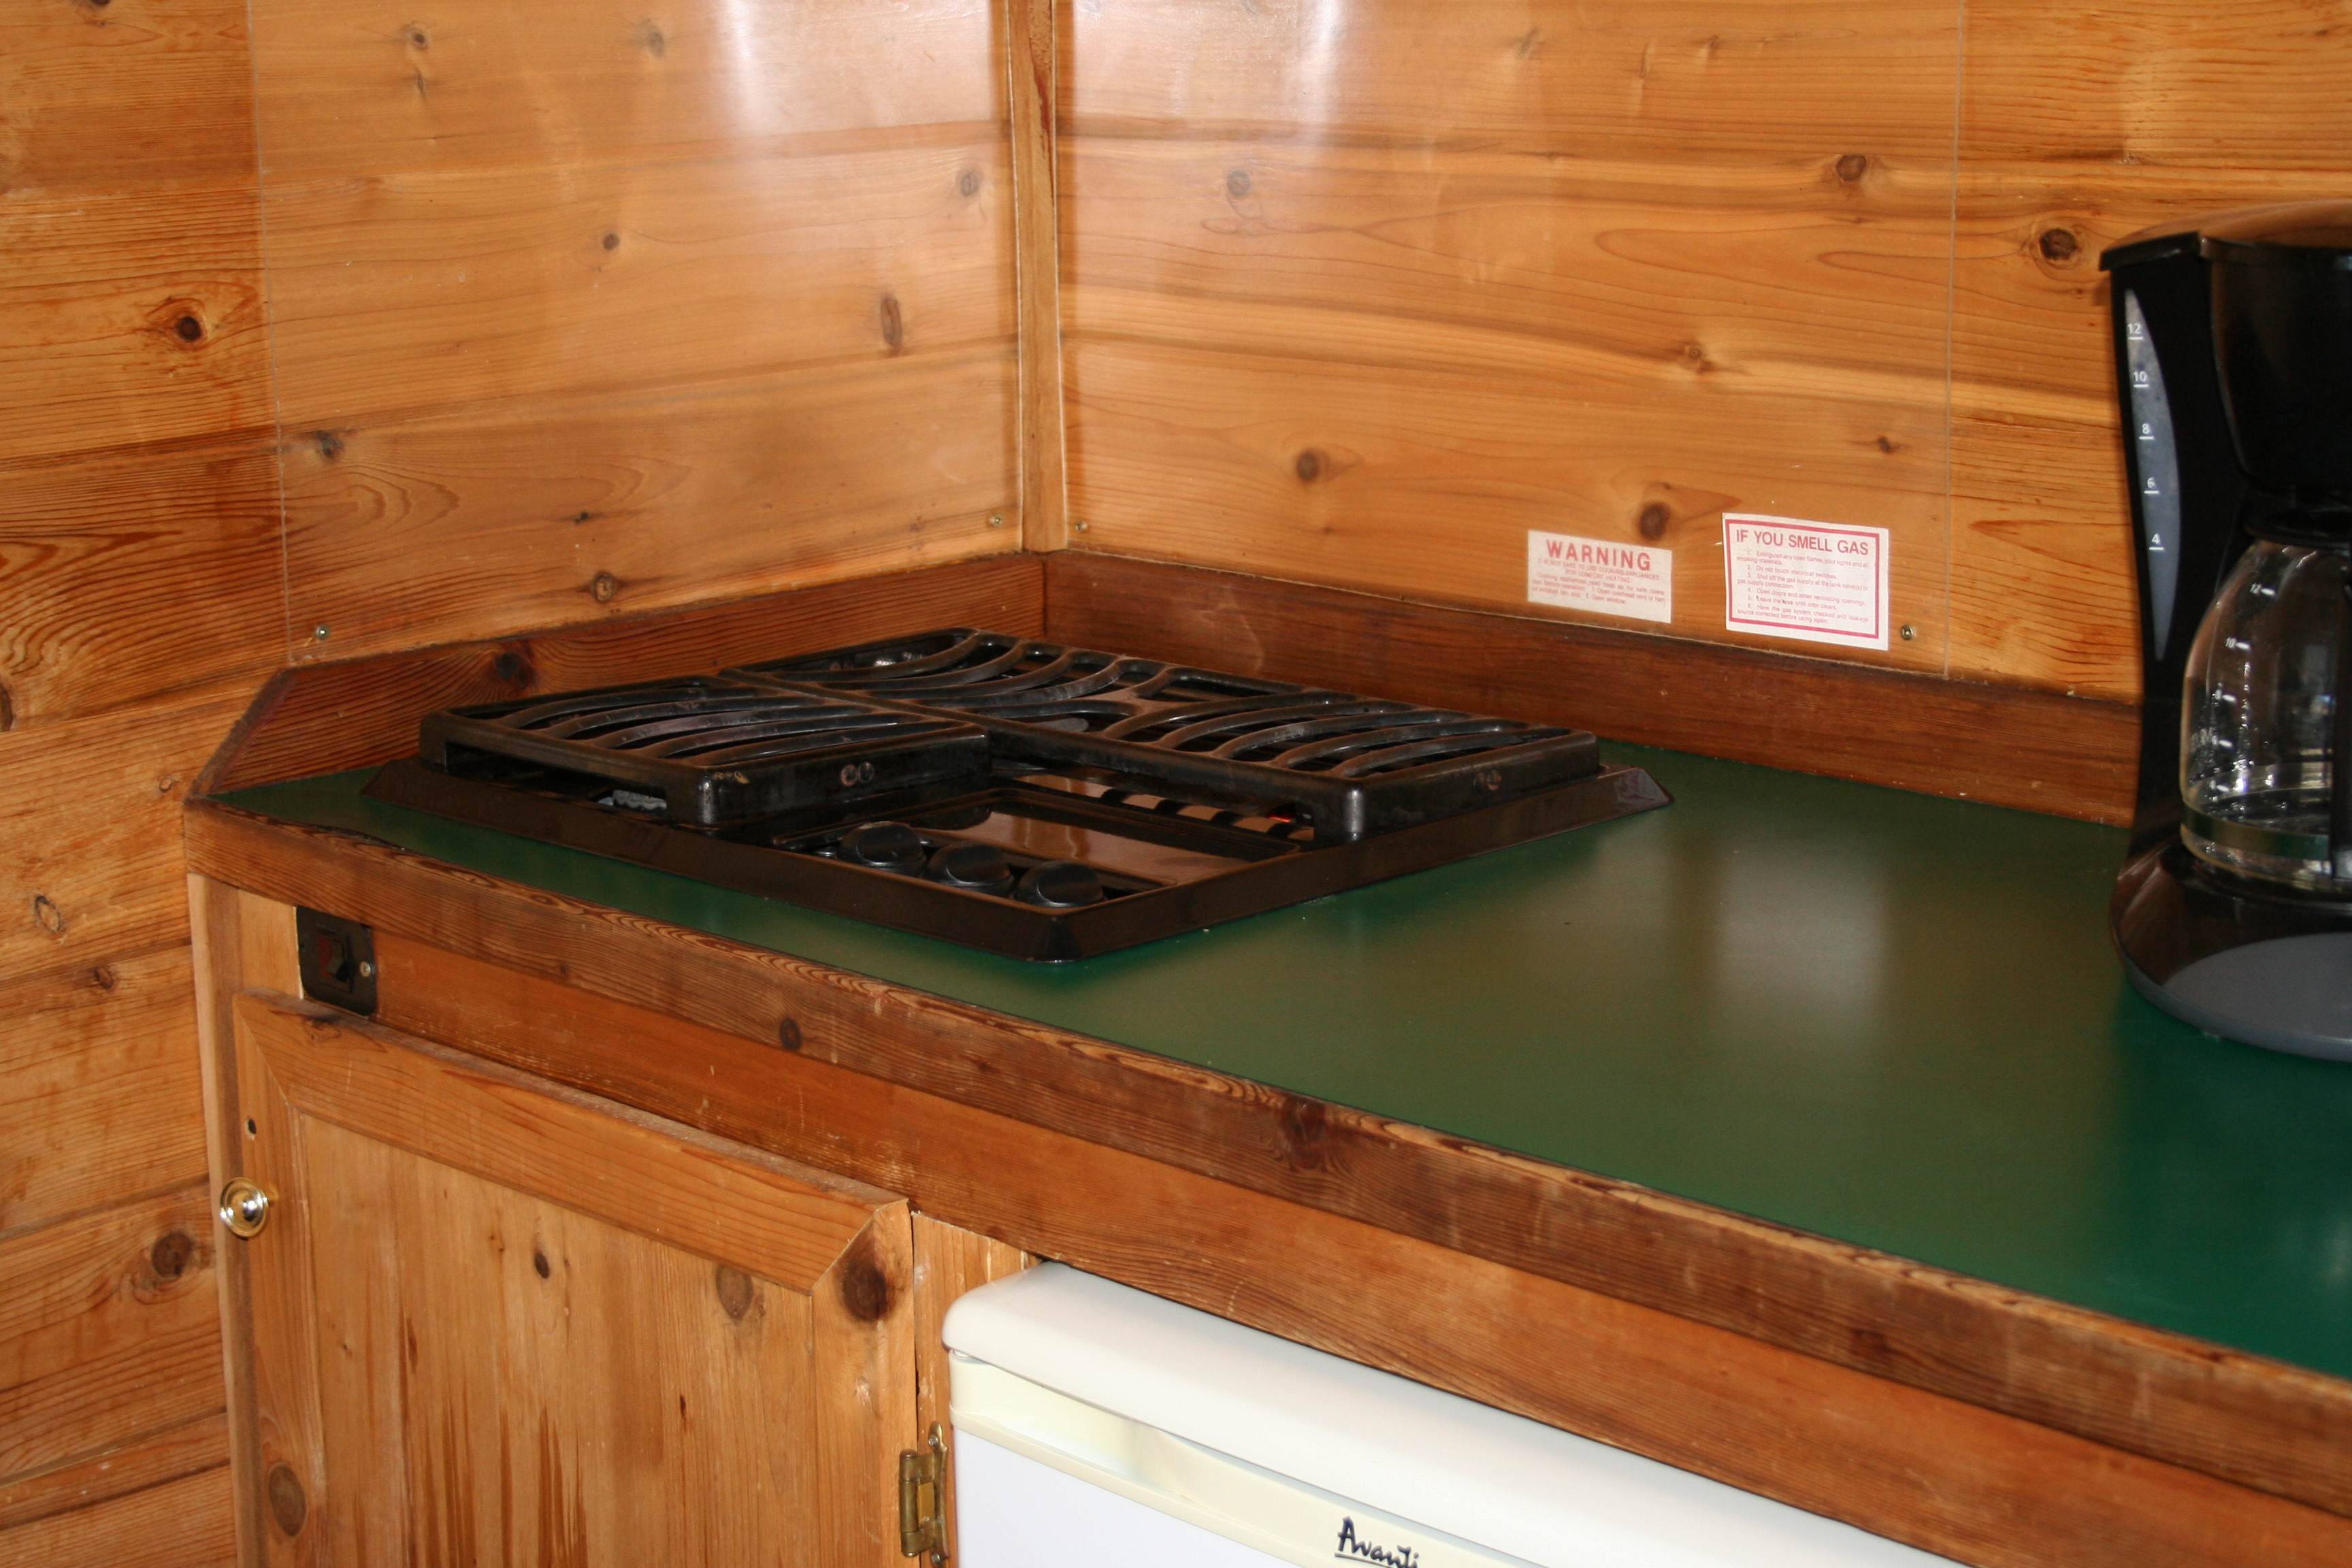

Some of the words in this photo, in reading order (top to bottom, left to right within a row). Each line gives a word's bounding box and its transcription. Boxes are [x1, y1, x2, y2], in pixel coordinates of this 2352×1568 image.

[2127, 323, 2141, 334] 12
[2133, 372, 2146, 382] 10
[2142, 424, 2149, 435] 8
[2147, 478, 2155, 489] 6
[1736, 529, 1748, 542] IF
[1754, 531, 1784, 546] YOU
[1788, 534, 1832, 552] SMELL
[1838, 540, 1868, 555] GAS
[2151, 534, 2160, 544] 4
[1546, 540, 1650, 571] WARNING
[1337, 1515, 1419, 1568] Avanti
